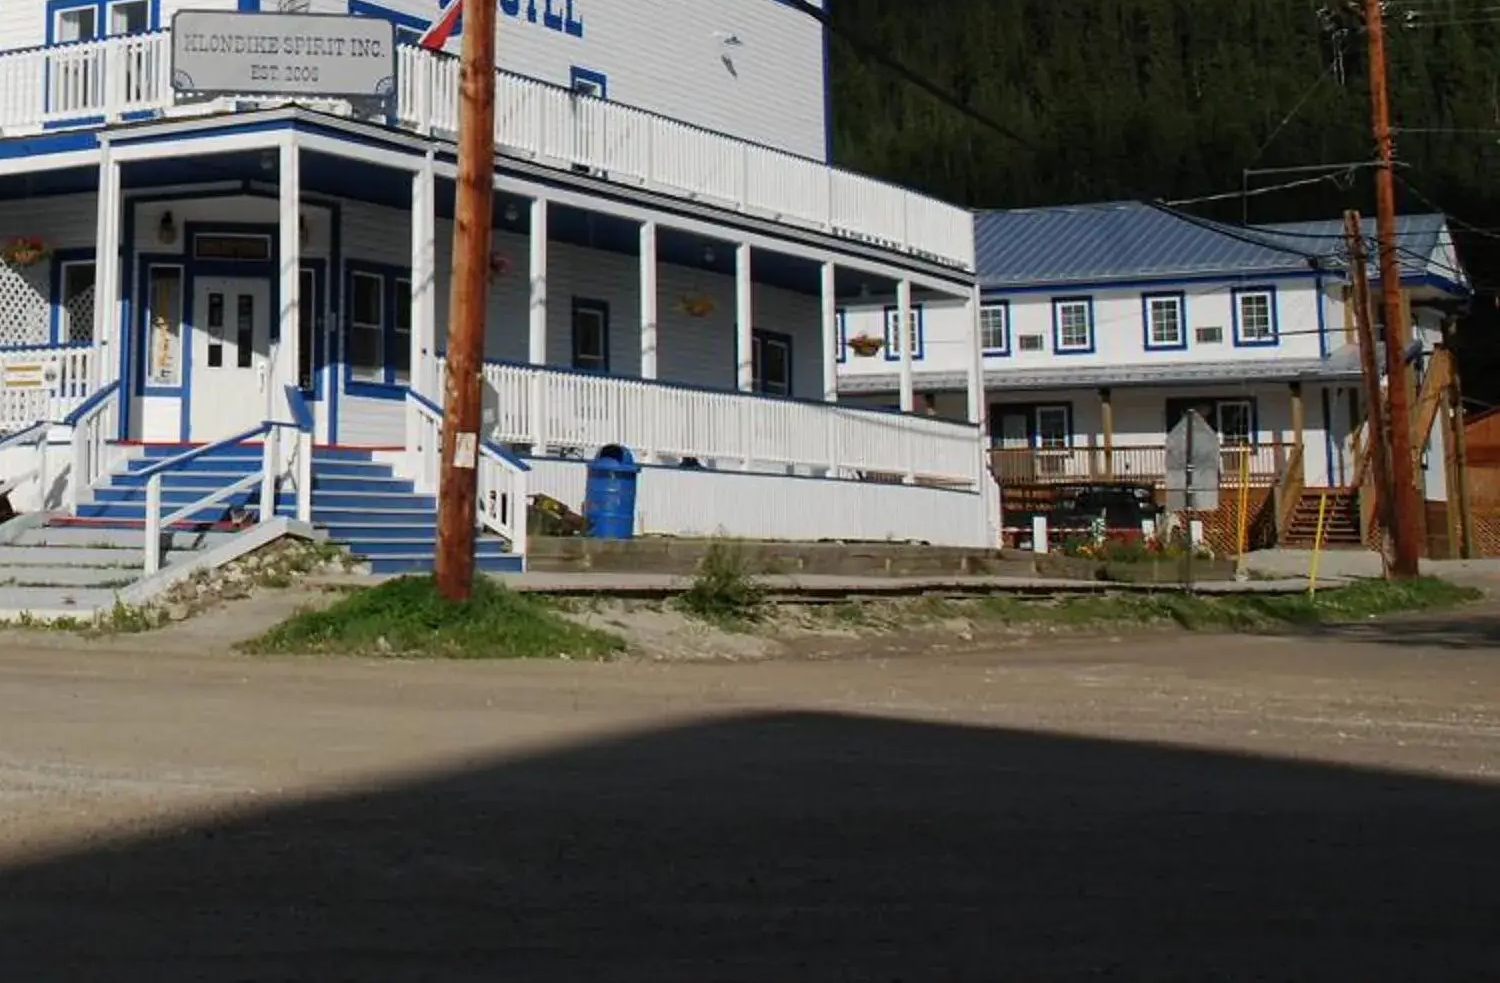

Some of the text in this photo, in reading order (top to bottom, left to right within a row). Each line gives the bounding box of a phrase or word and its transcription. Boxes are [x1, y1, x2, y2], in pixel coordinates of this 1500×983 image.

[184, 33, 385, 58] KLONDIKE SPIRIT INC.
